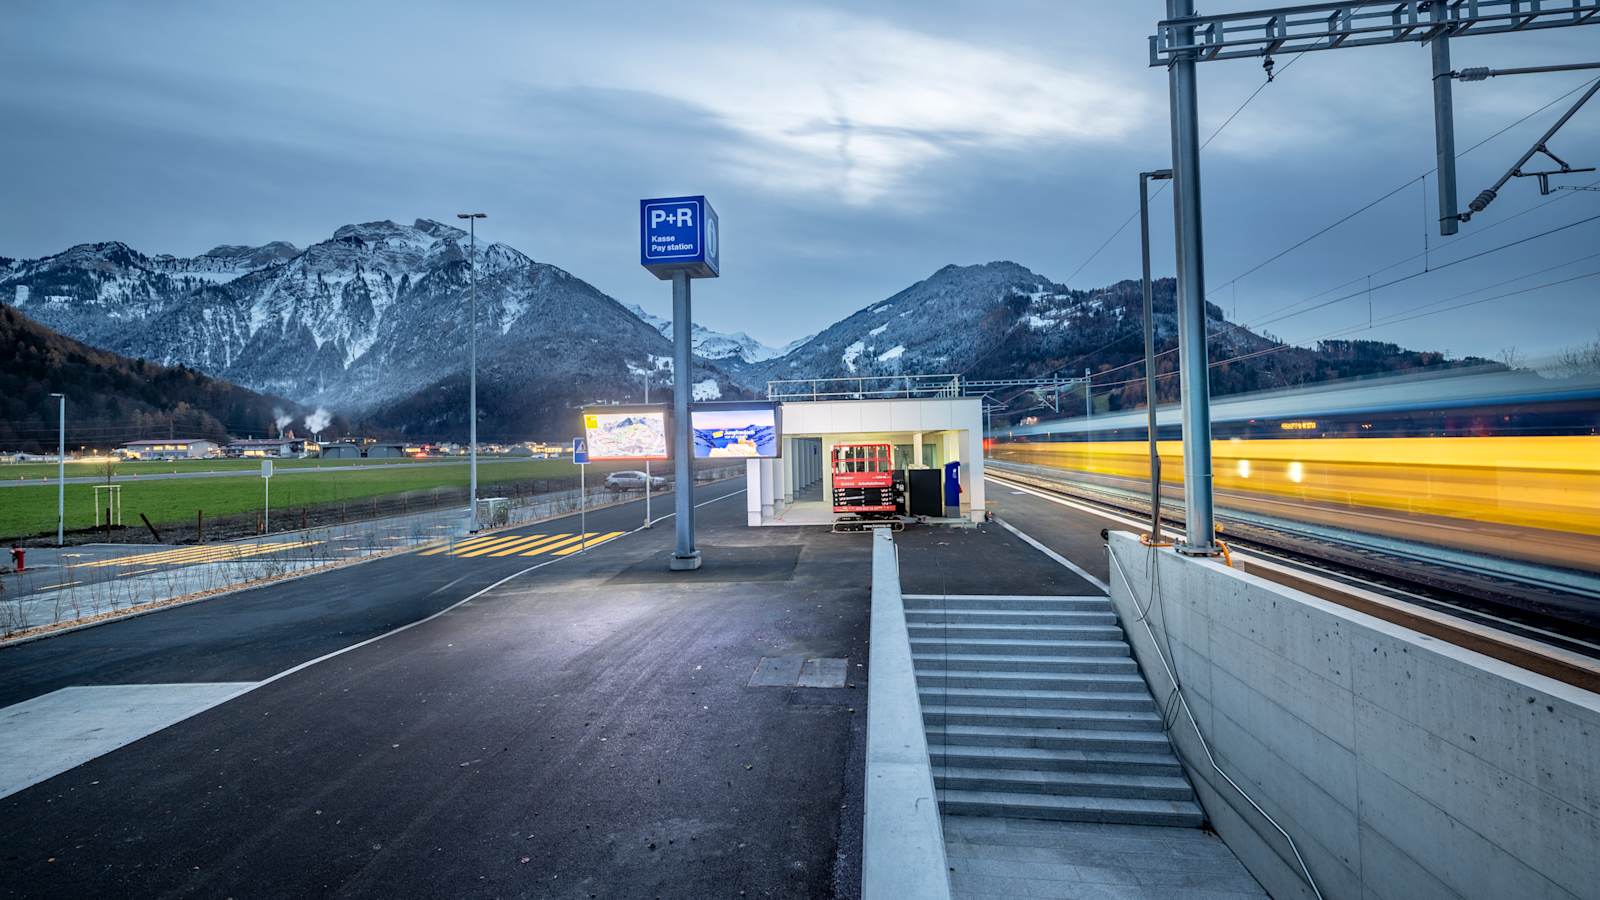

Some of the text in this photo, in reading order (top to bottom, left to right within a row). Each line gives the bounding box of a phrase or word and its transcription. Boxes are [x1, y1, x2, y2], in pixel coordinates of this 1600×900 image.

[651, 208, 693, 229] P+R
[651, 235, 676, 243] Kasse
[651, 243, 693, 253] Pay station
